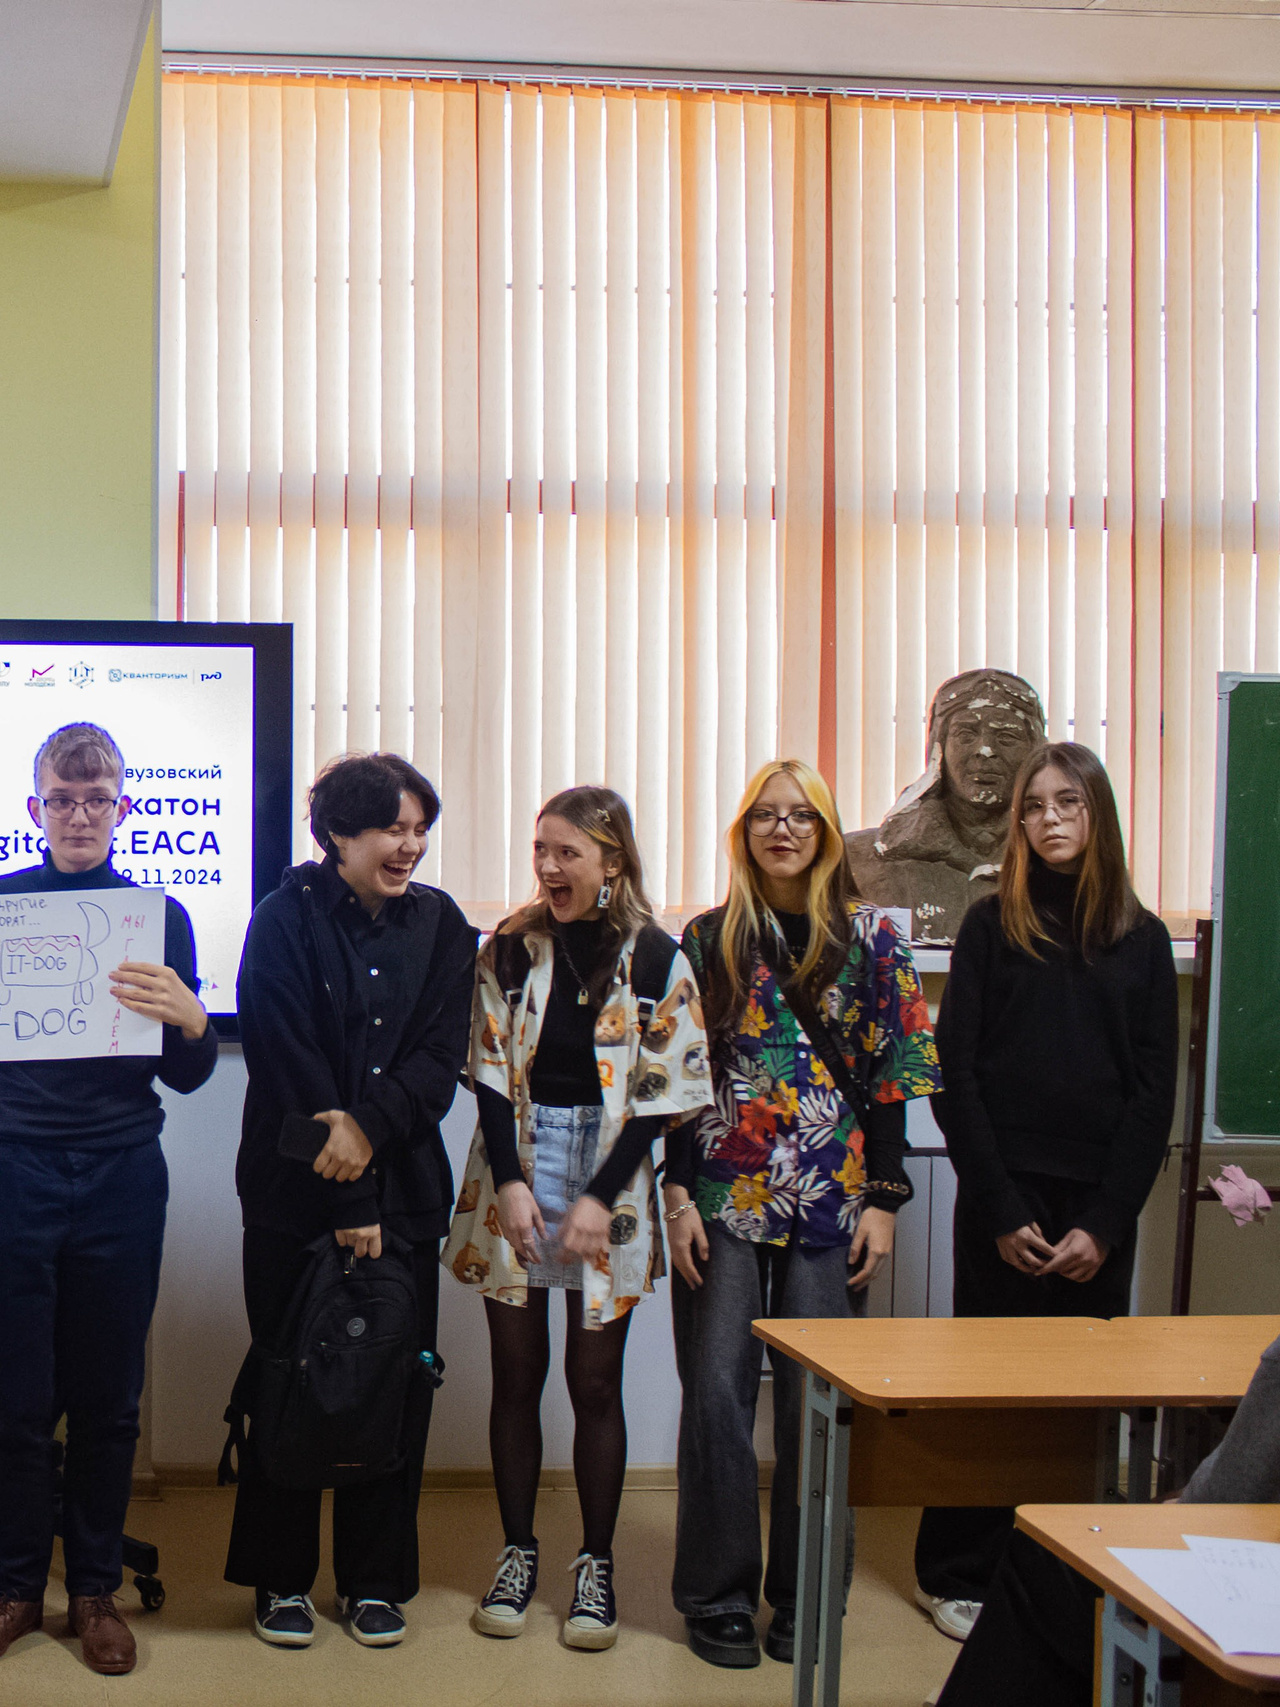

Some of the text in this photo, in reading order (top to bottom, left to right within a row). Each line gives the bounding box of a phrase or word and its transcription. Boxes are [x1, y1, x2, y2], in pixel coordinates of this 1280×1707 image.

[123, 672, 188, 680] КВАНТОРИУМ
[125, 765, 222, 782] вузовский
[127, 797, 221, 816] катон
[121, 915, 146, 929] МЫ
[6, 954, 68, 975] IT-DOG
